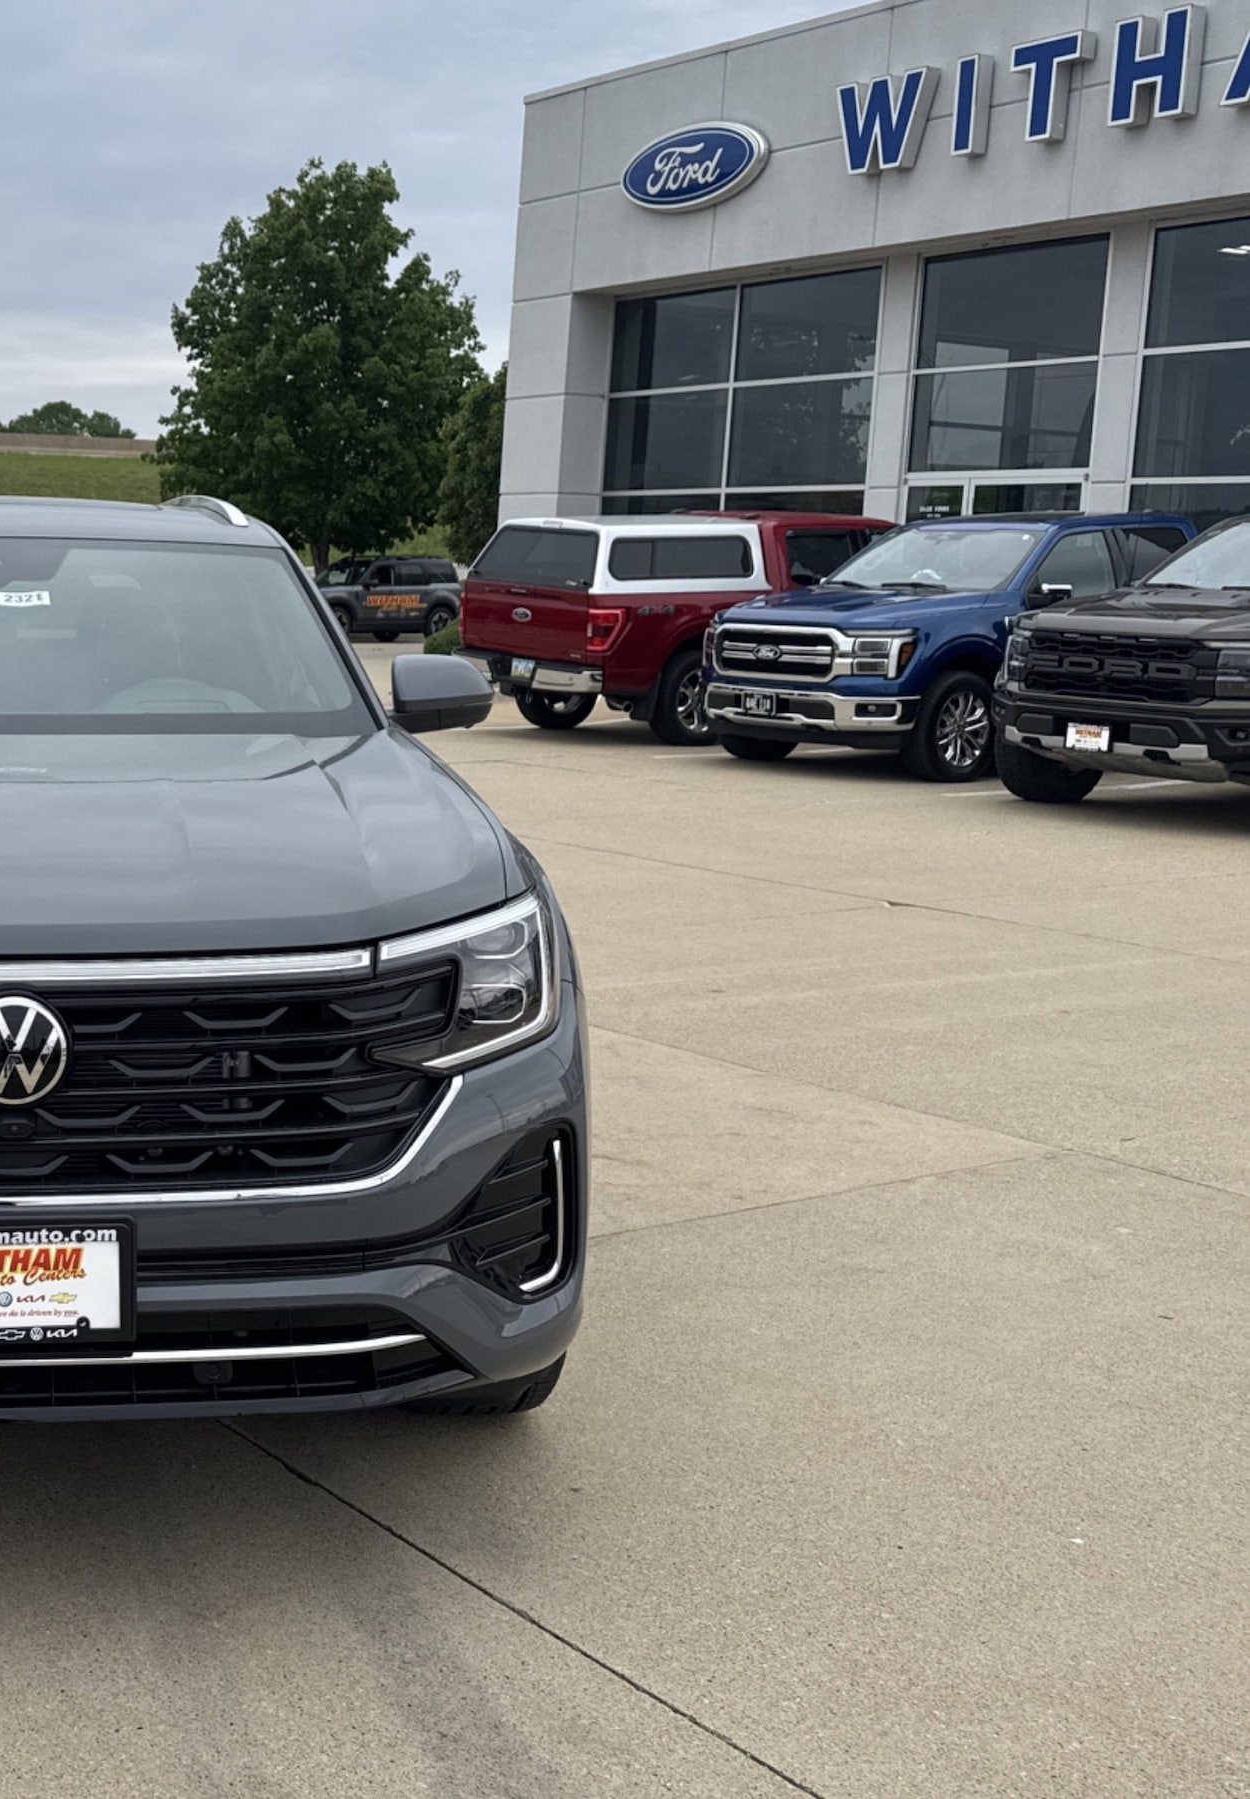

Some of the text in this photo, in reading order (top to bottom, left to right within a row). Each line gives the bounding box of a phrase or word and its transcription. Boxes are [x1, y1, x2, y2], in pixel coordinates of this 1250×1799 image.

[646, 142, 724, 195] Ford
[1026, 652, 1198, 681] FORD
[23, 1266, 87, 1286] Centers
